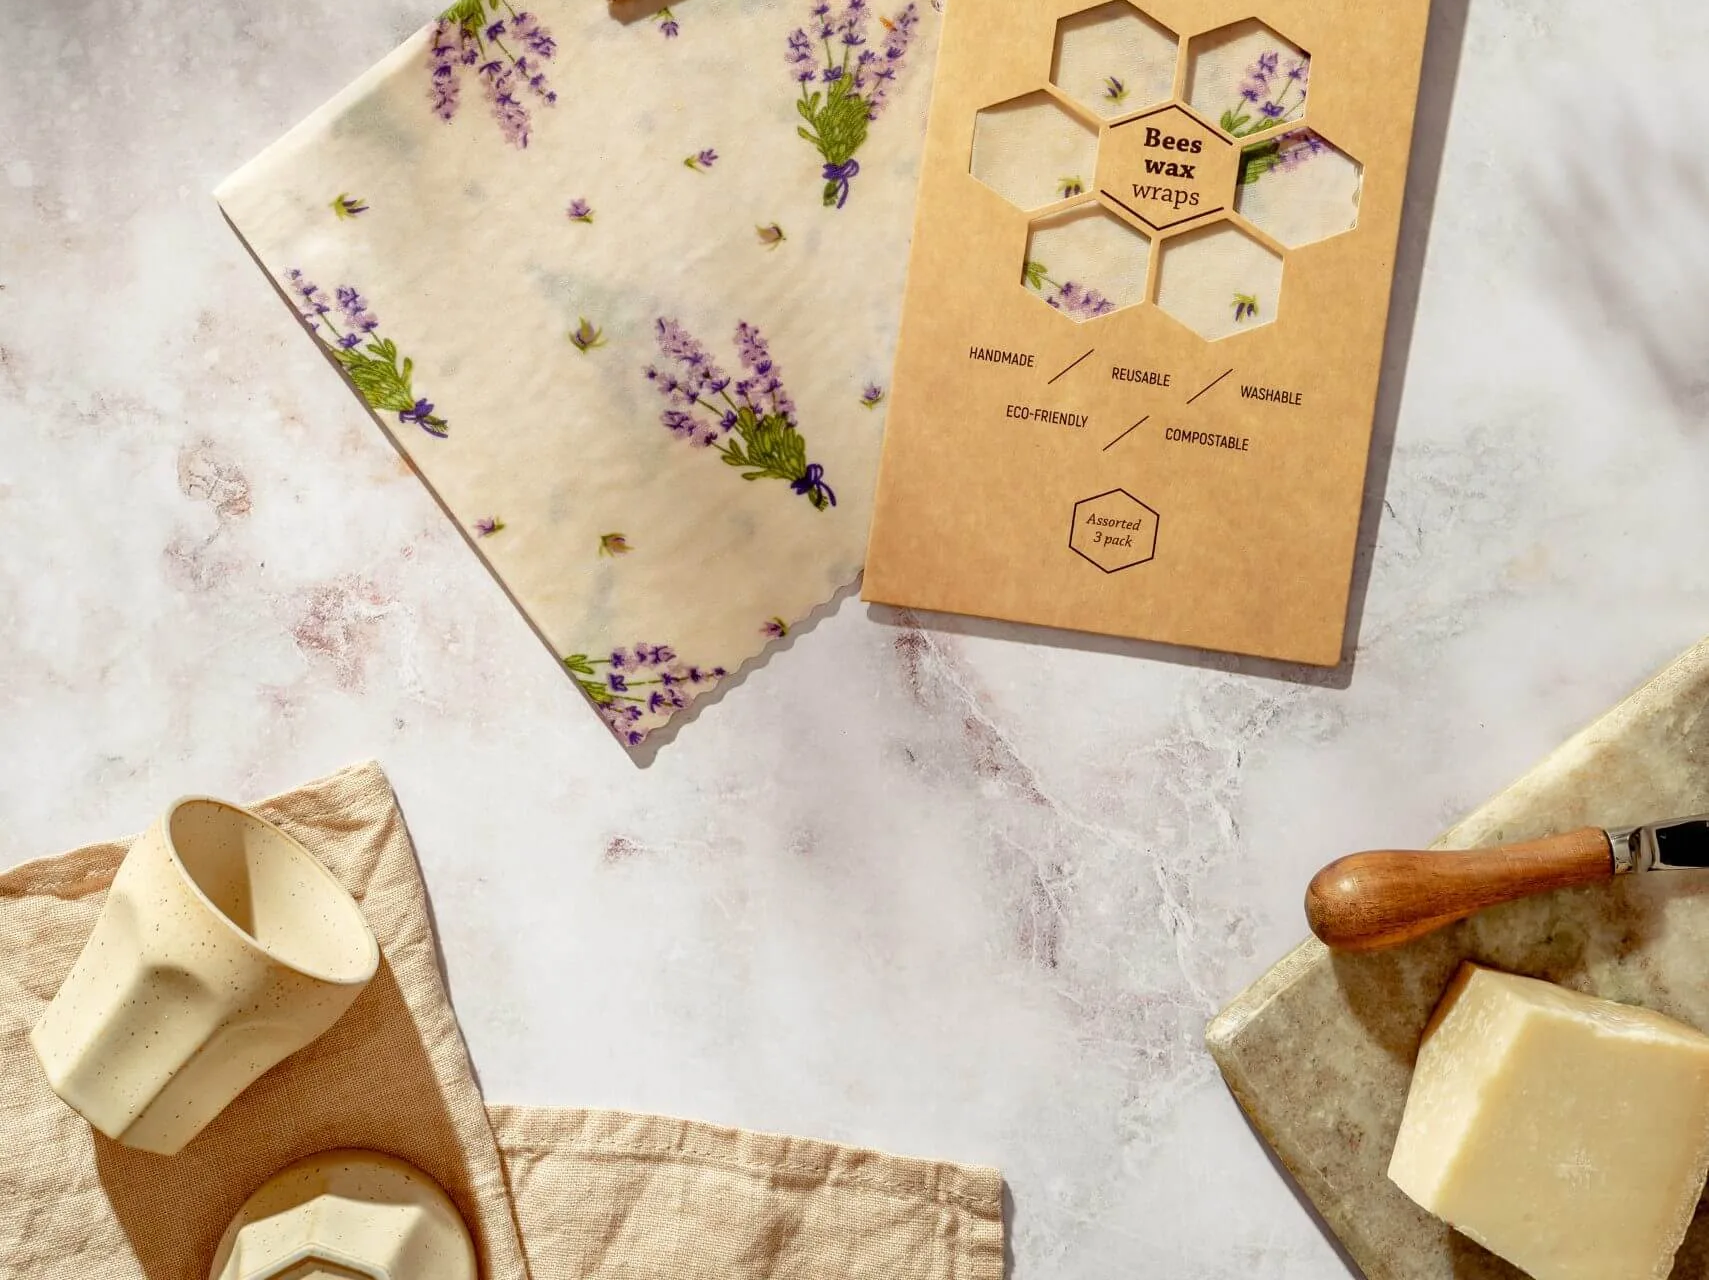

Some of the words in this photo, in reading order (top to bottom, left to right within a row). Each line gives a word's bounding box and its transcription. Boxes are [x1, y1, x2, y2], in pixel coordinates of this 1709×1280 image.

[1144, 127, 1202, 154] Bees
[1144, 156, 1195, 179] wax
[1132, 182, 1200, 209] wraps
[969, 346, 1035, 368] HANDMADE
[1112, 367, 1171, 387] REUSABLE
[1240, 385, 1303, 406] WASHABLE
[1006, 405, 1089, 428] ECO-FRIENDLY
[1165, 427, 1250, 451] COMPOSTABLE
[1086, 512, 1142, 531] Assorted
[1093, 531, 1103, 543] 3
[1104, 534, 1133, 548] pack
